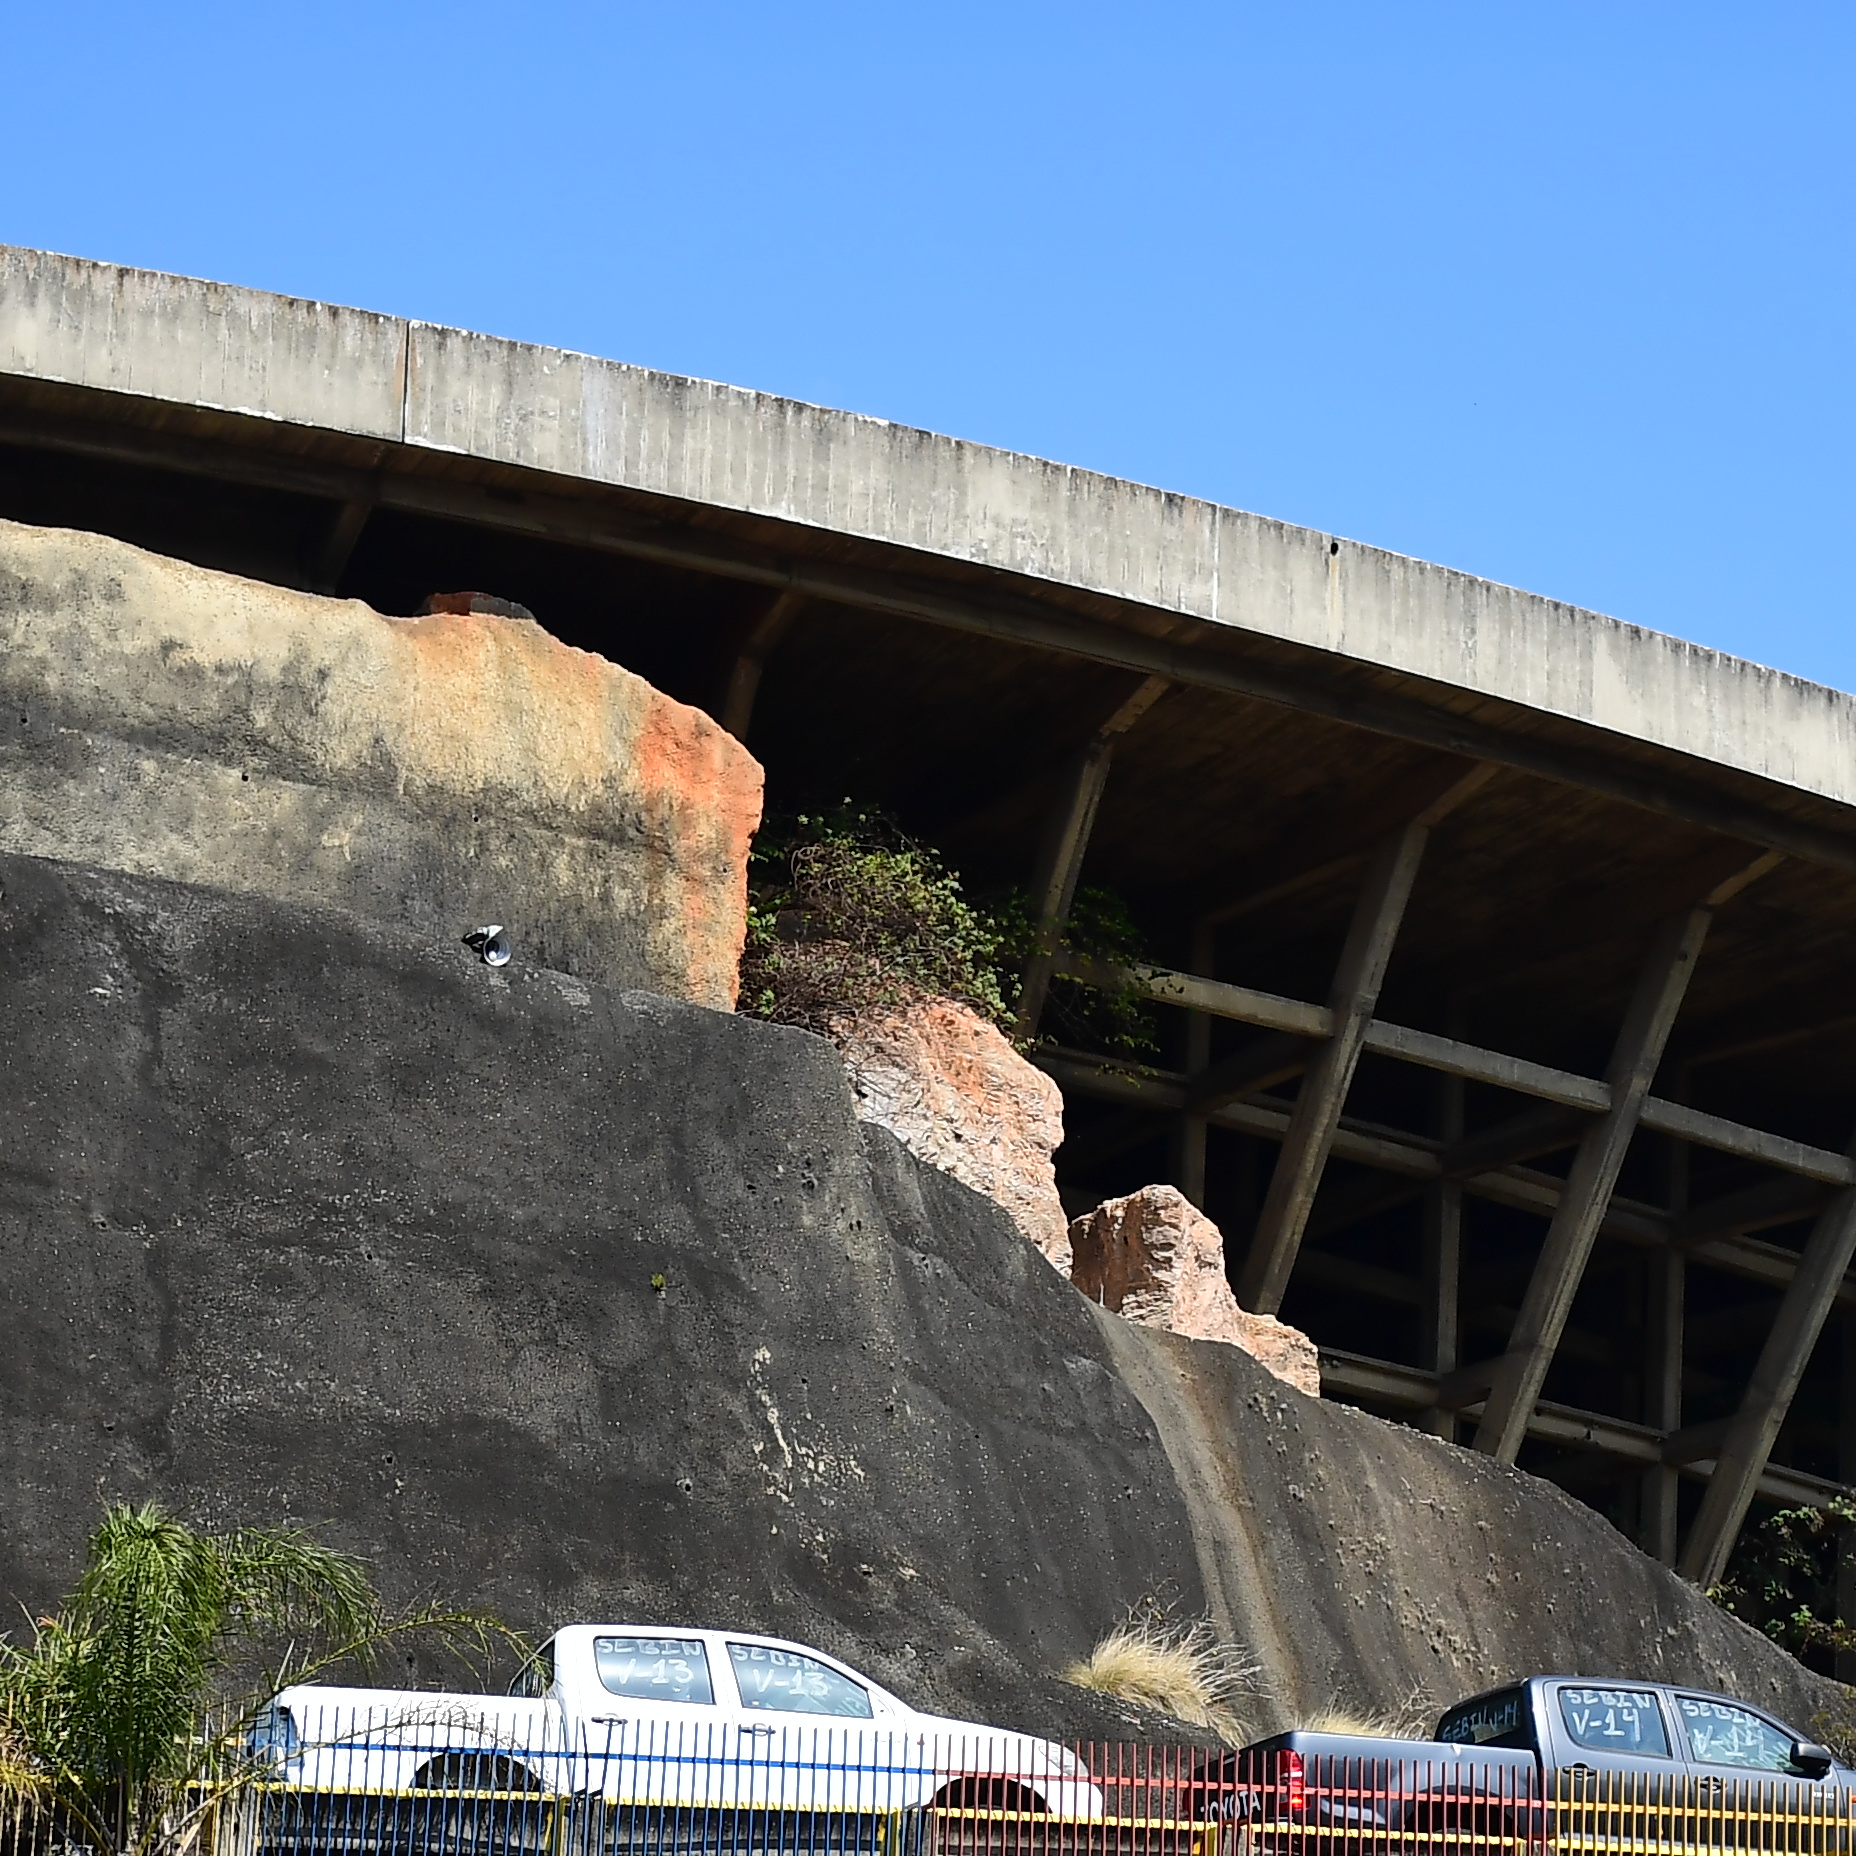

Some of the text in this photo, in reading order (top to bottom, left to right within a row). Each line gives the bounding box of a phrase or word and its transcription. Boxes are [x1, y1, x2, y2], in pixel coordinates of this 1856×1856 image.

[596, 1639, 701, 1656] SEBIN
[734, 1645, 820, 1671] SEBIN
[617, 1658, 694, 1684] V-13
[752, 1668, 830, 1696] V-13
[1563, 1688, 1651, 1710] SEBIN
[1571, 1709, 1641, 1742] V-14
[1682, 1700, 1762, 1728] SEBIN
